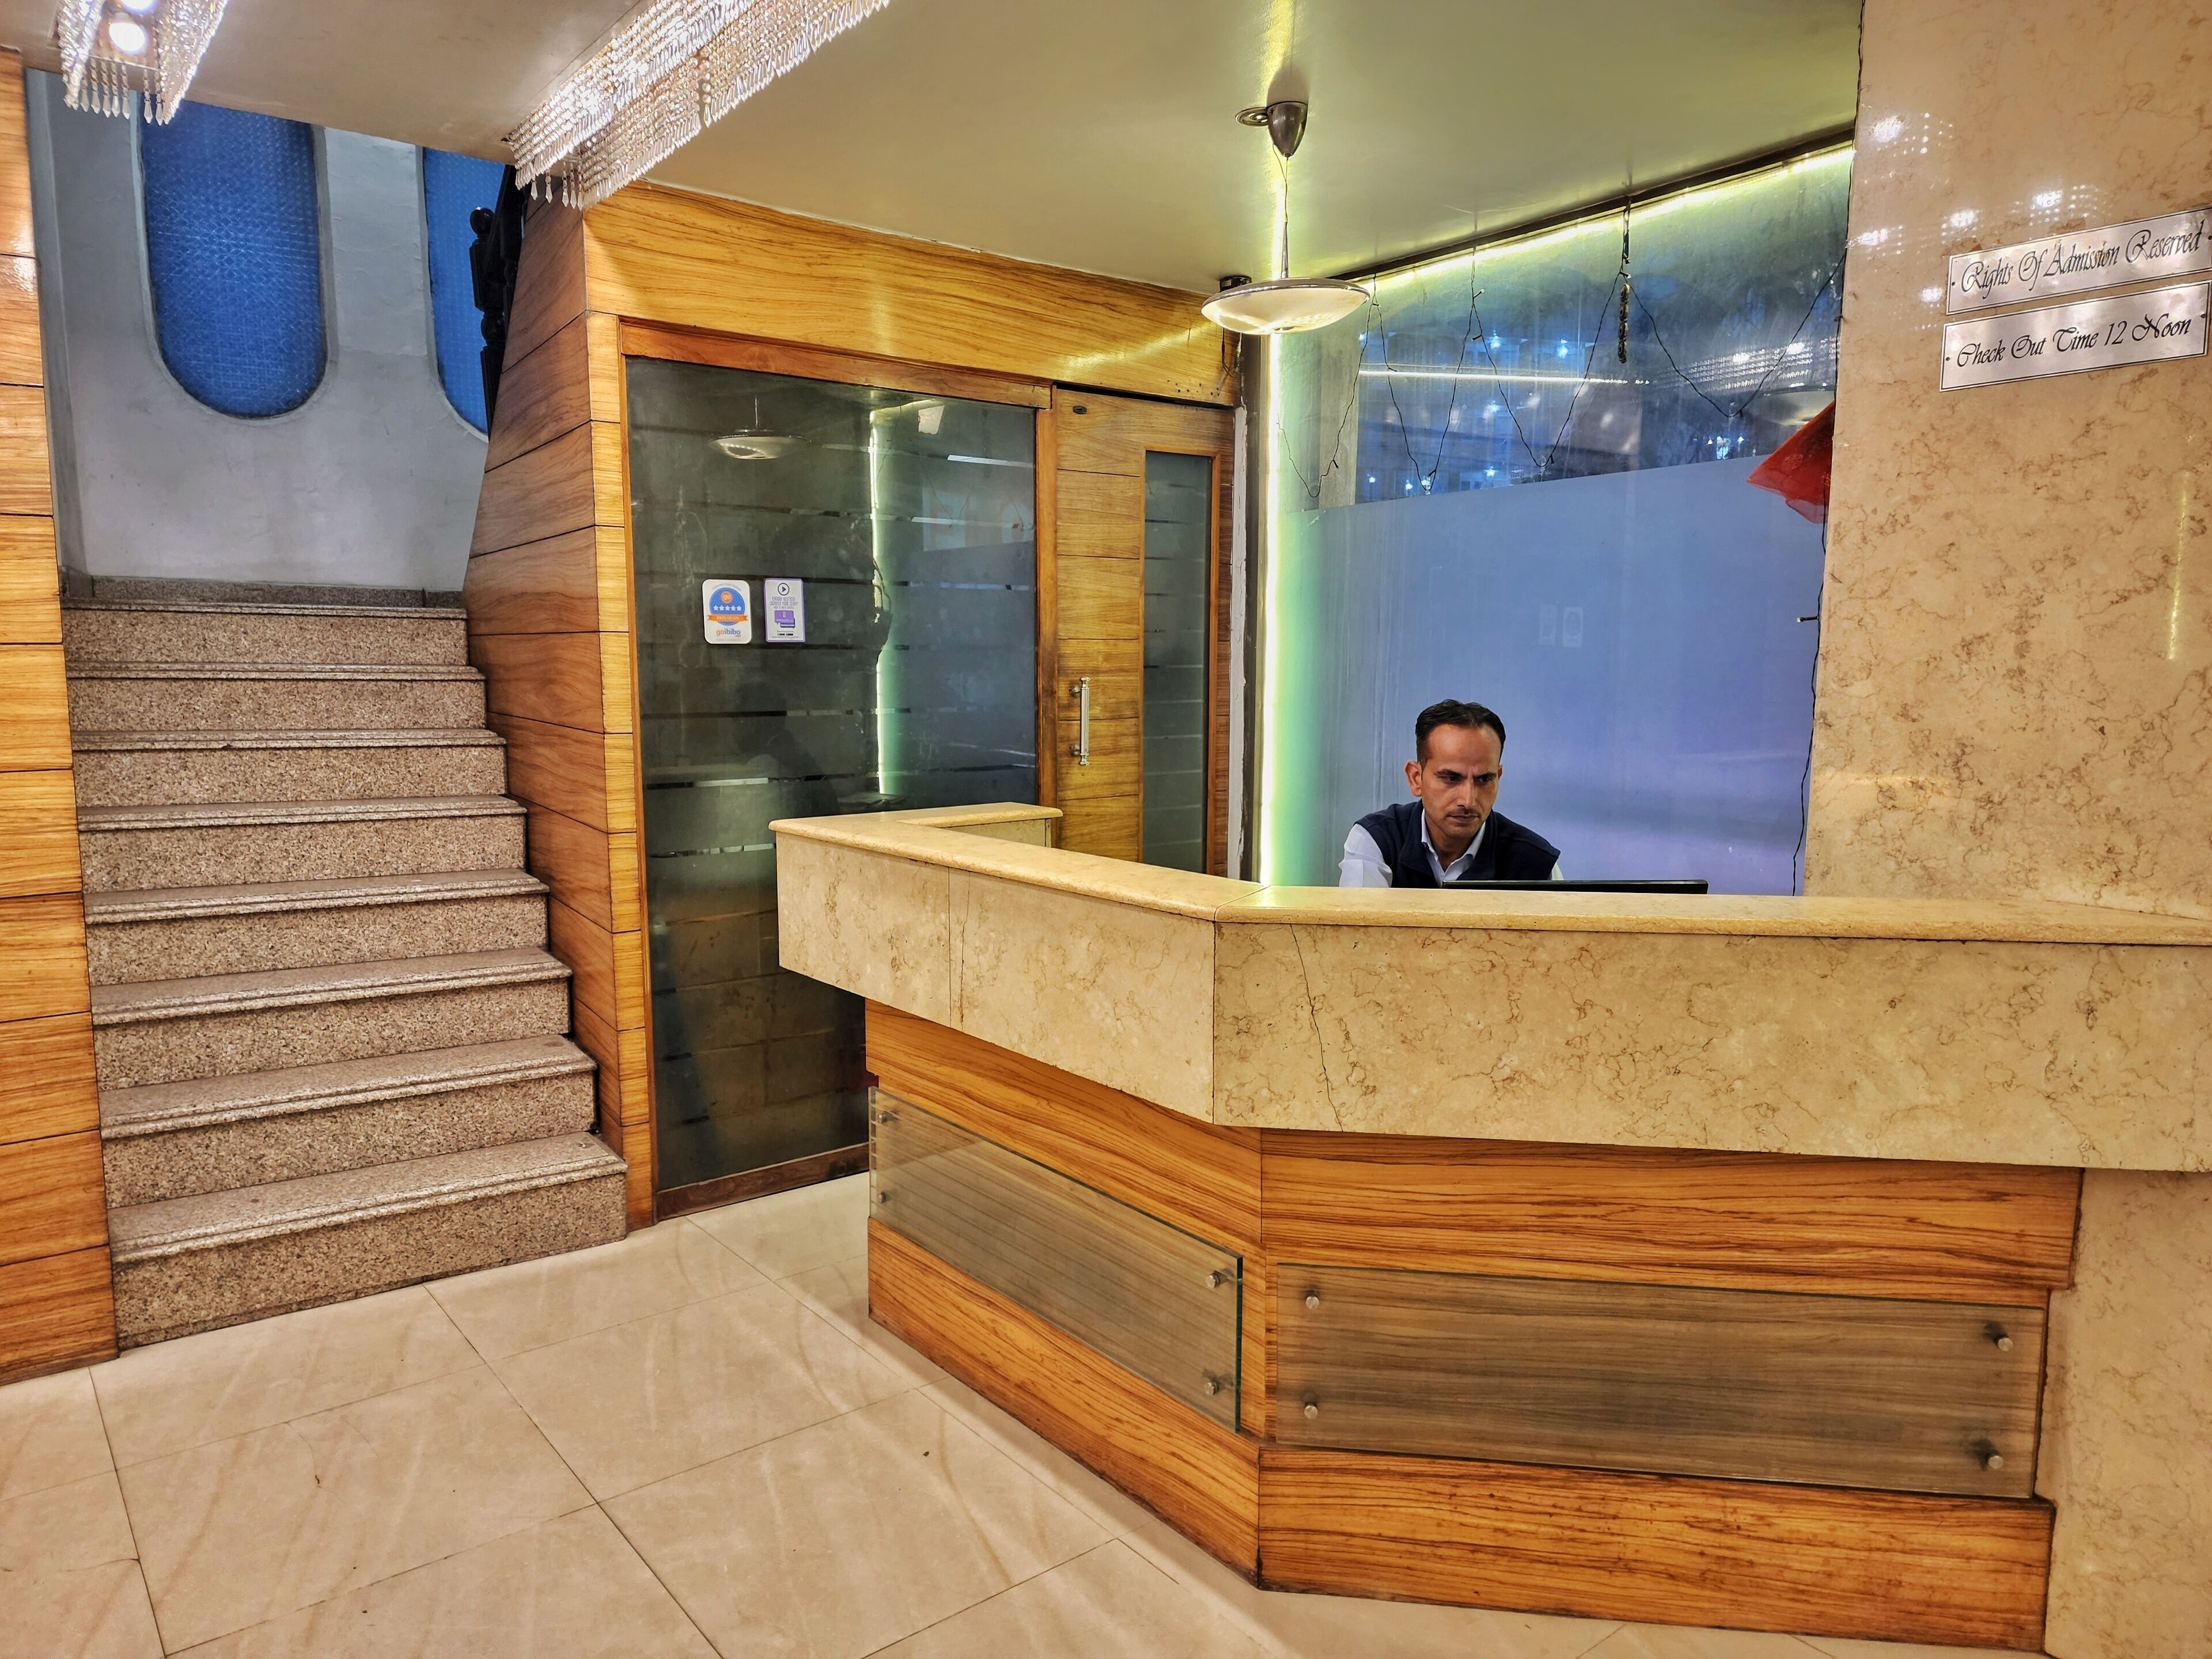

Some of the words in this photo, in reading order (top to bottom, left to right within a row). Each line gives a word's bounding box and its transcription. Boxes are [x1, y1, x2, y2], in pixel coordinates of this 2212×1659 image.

[1961, 261, 2014, 300] Rights
[2018, 249, 2048, 291] Of
[2043, 242, 2121, 277] Admission
[2125, 219, 2205, 264] Reserved
[1957, 340, 2005, 368] Check
[2011, 335, 2046, 359] Out
[2052, 327, 2099, 352] Time
[2104, 321, 2127, 347] 12
[2131, 313, 2192, 341] Noon
[716, 628, 741, 637] goibibo
